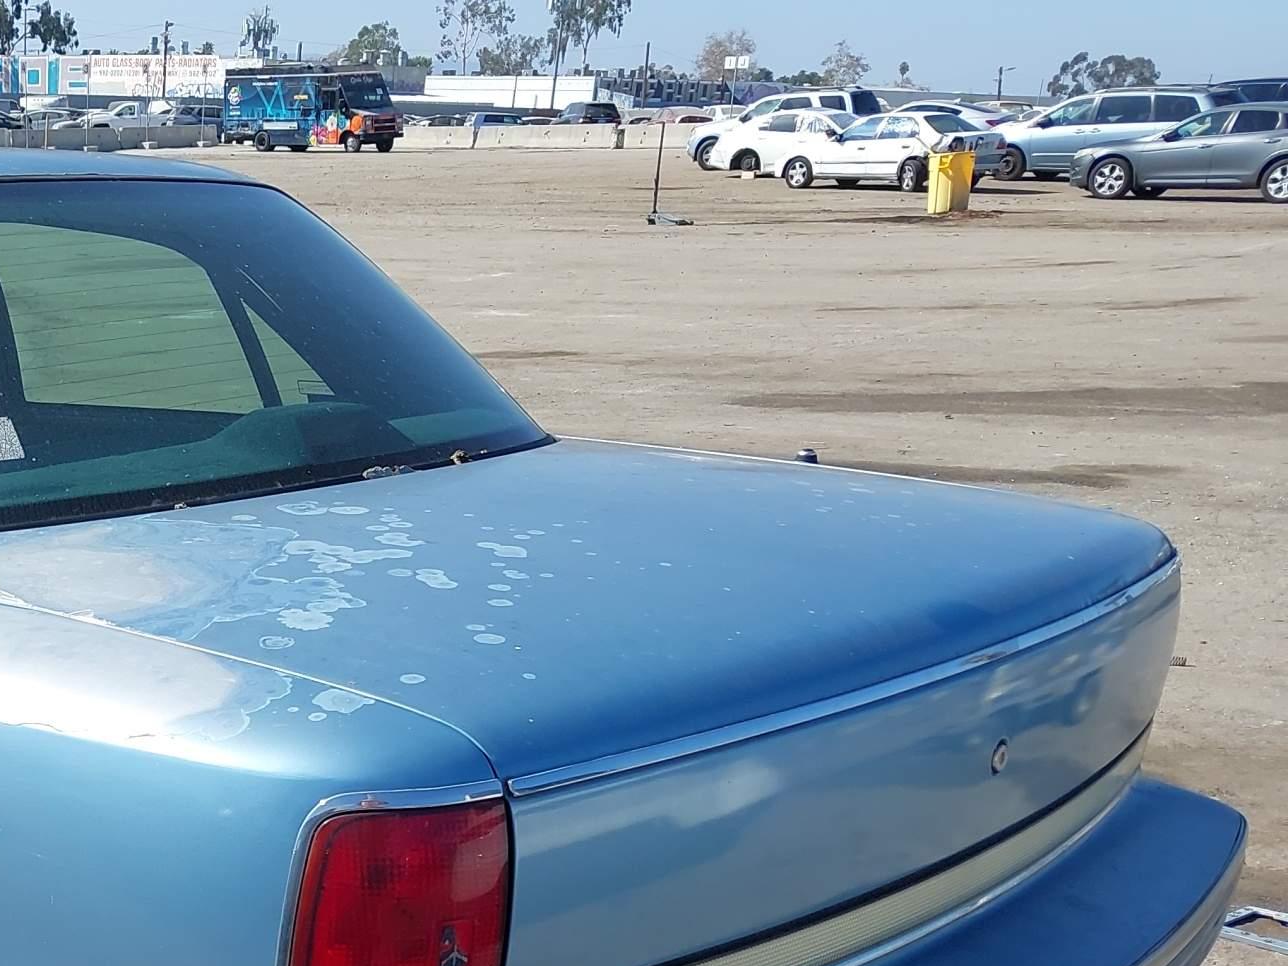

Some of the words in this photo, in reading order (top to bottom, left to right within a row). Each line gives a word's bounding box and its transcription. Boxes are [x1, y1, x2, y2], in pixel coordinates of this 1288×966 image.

[93, 58, 110, 67] AUTO
[154, 58, 217, 68] PATS-RADIATORS
[83, 64, 89, 74] 3
